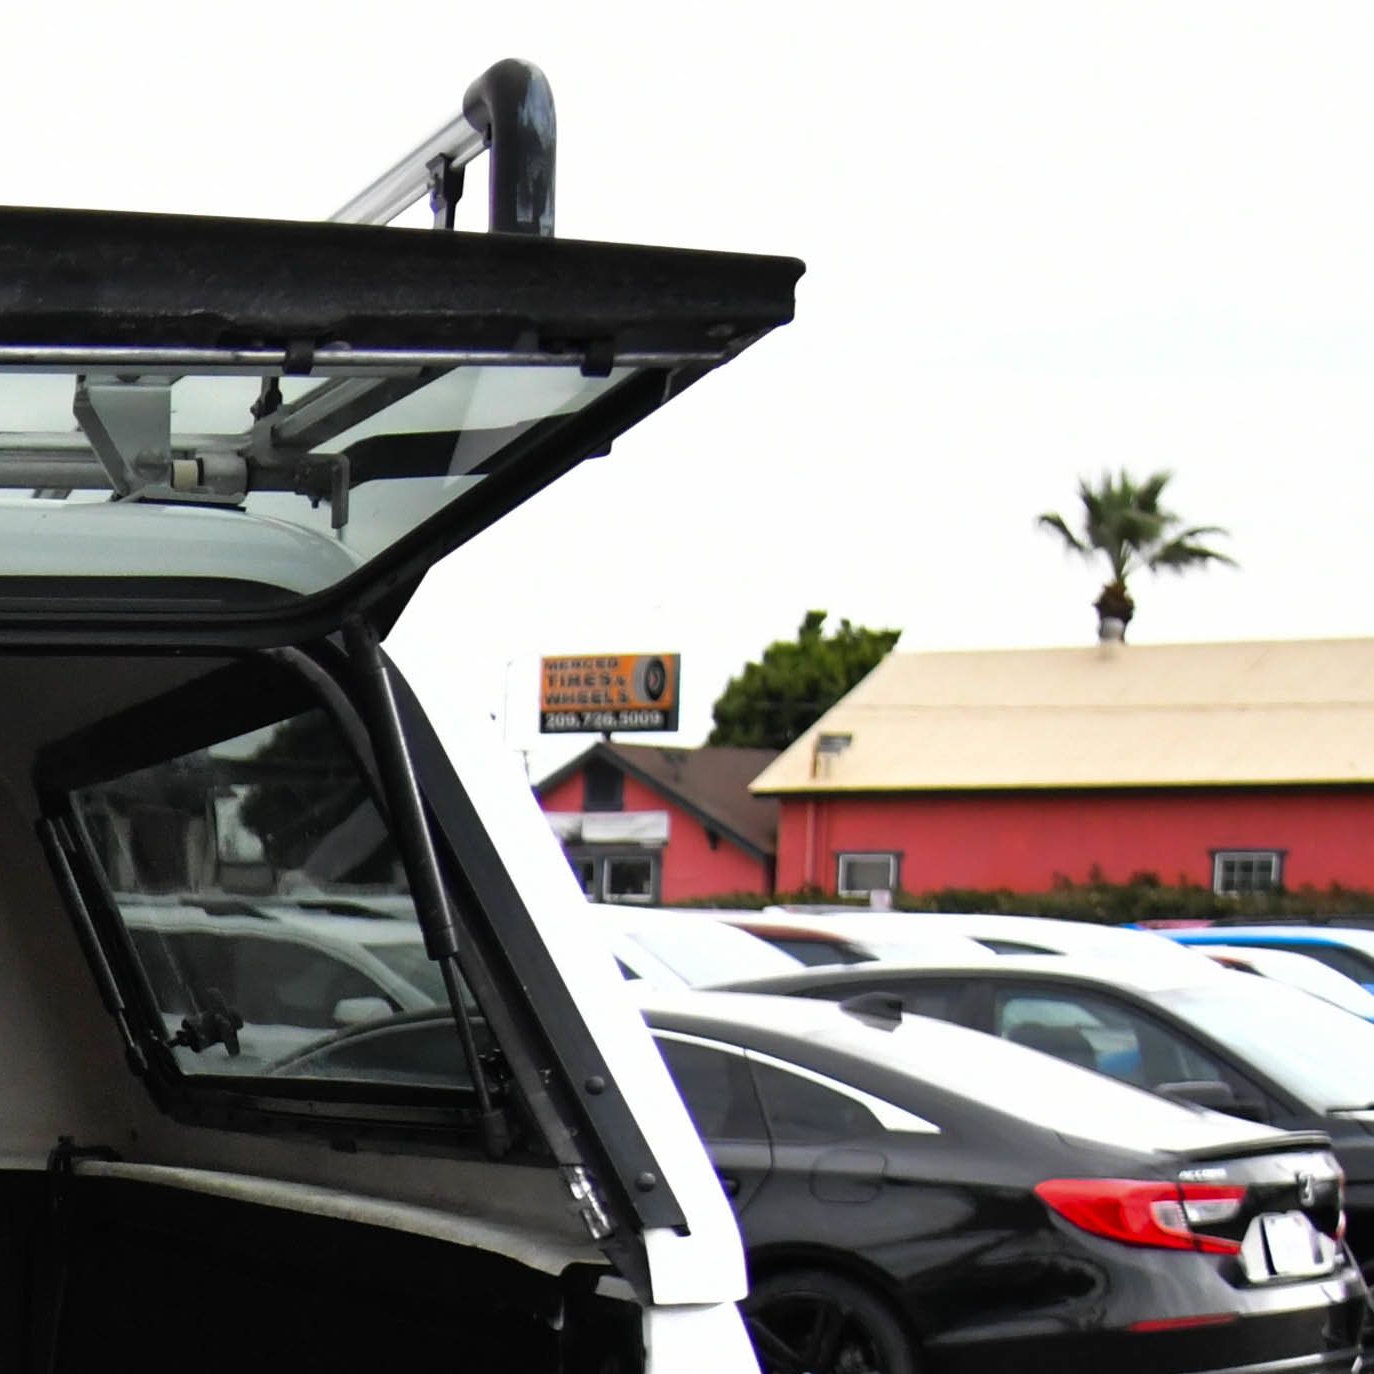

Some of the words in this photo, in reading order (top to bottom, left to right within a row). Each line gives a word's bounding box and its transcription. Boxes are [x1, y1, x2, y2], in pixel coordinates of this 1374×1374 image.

[545, 658, 619, 671] MERCED
[547, 672, 612, 687] TIRES
[545, 689, 630, 705] WHEELS
